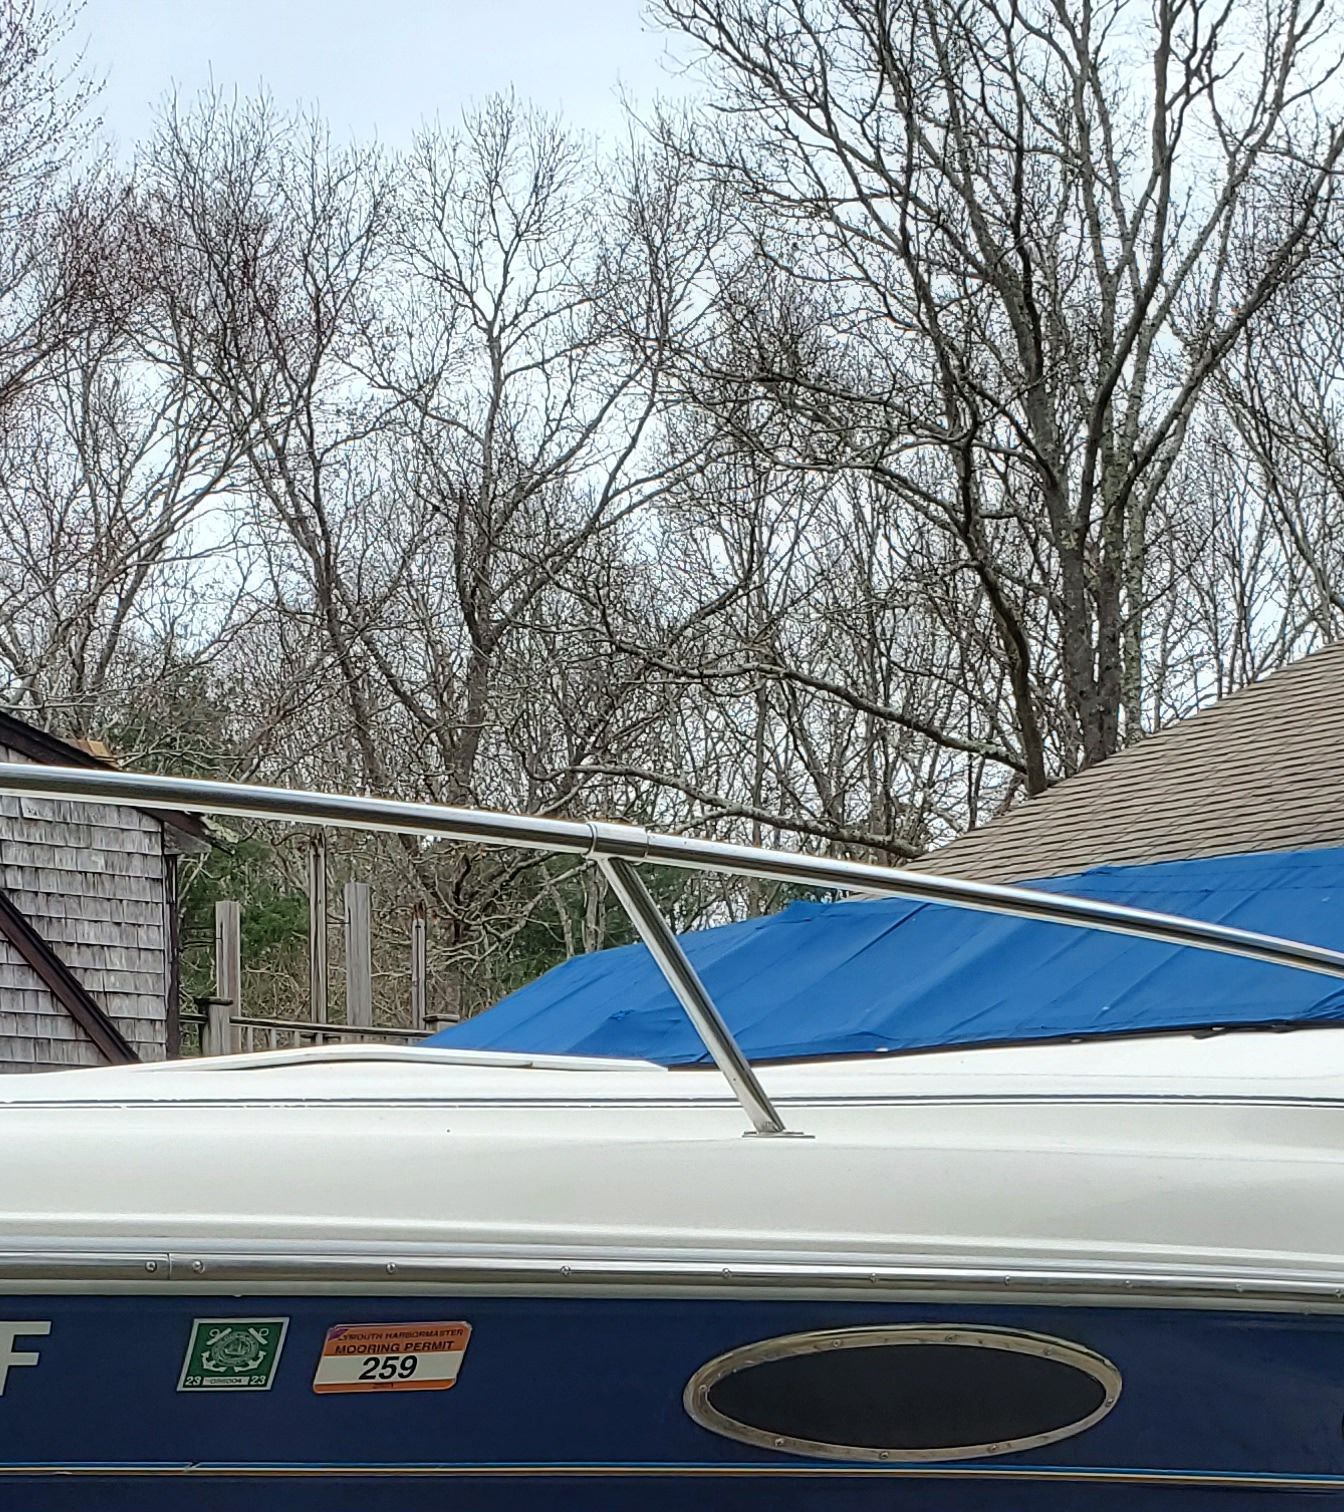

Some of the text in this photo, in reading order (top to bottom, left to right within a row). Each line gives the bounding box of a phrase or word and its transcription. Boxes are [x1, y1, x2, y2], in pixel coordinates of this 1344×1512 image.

[334, 1340, 456, 1355] MOORING PERMIT
[358, 1354, 419, 1381] 259
[249, 1374, 267, 1386] 23
